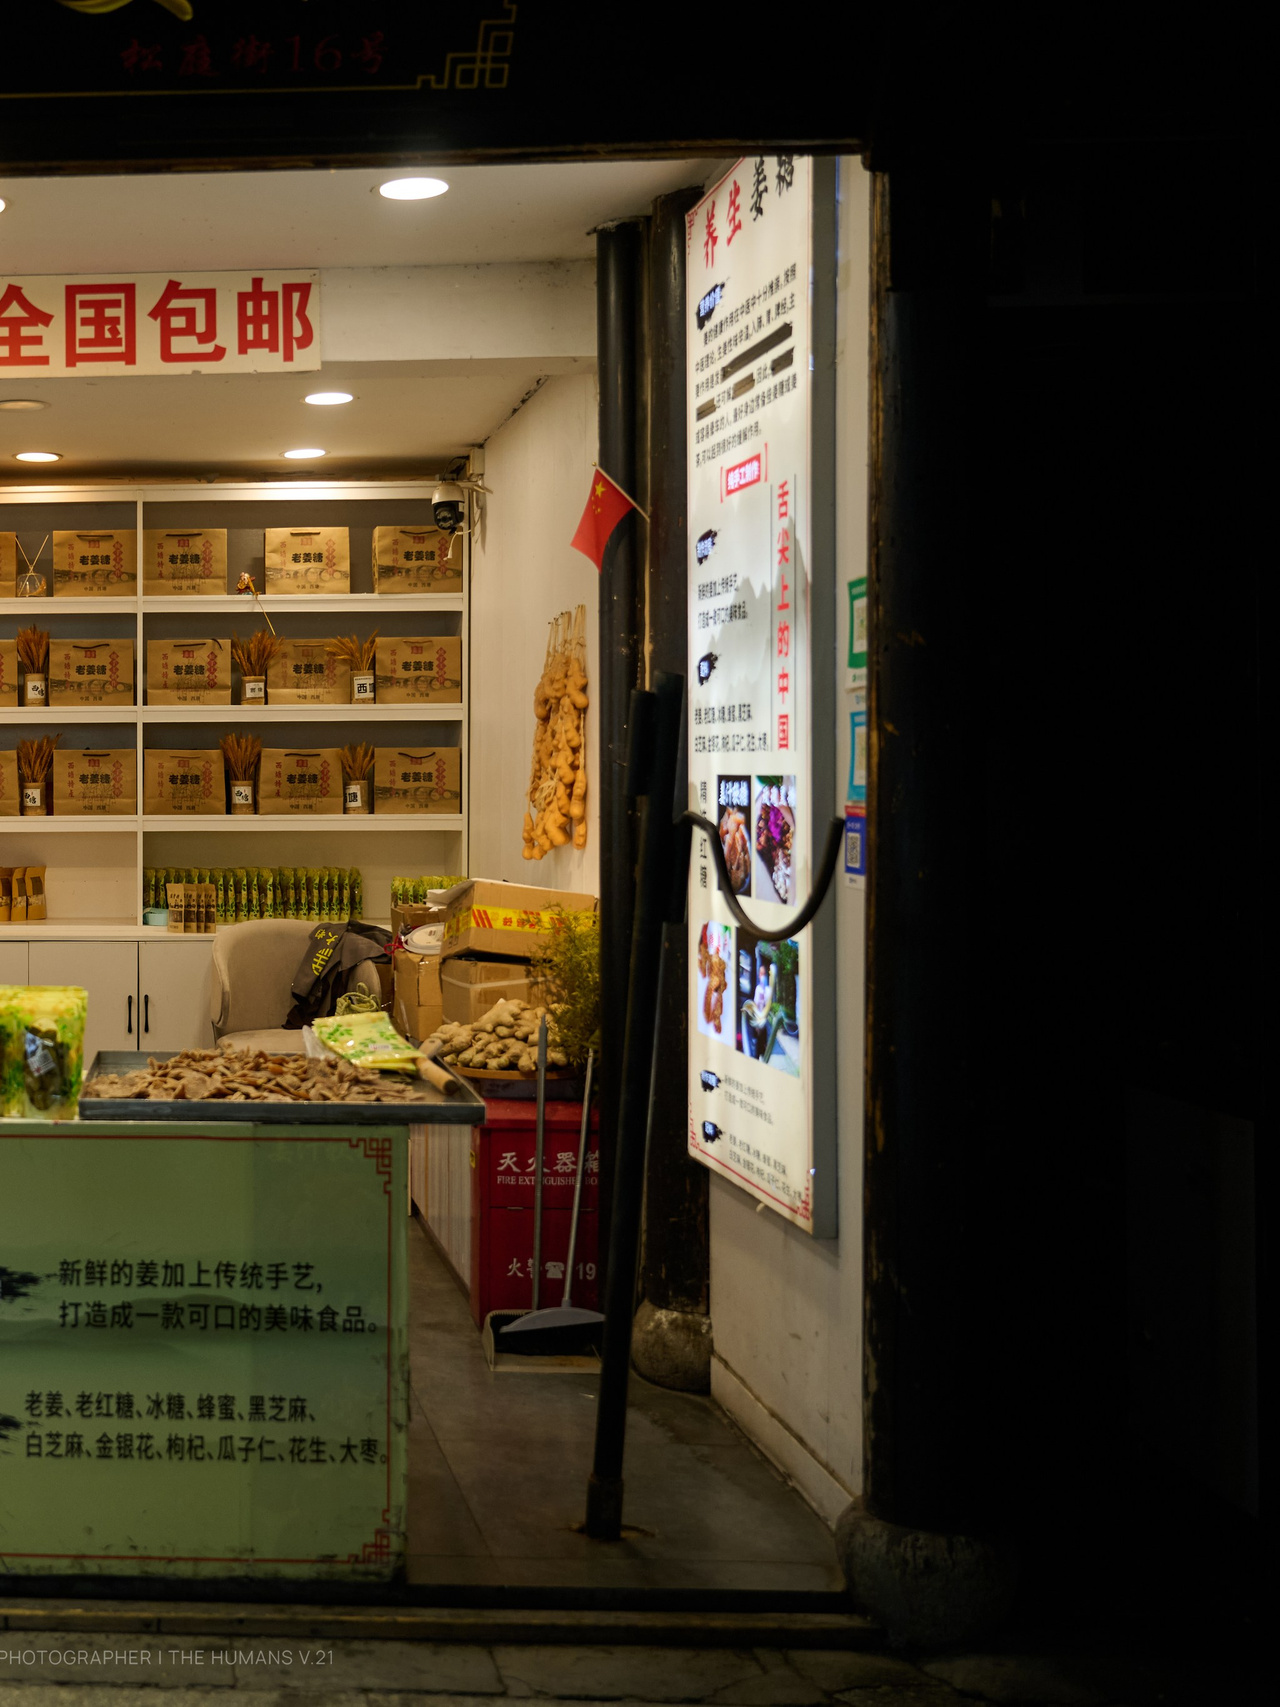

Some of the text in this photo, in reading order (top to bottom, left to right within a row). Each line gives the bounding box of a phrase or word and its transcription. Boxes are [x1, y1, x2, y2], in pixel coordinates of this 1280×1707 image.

[80, 555, 111, 565] 老姜糖
[168, 554, 200, 564] 老姜糖
[292, 552, 323, 563] 老姜糖
[404, 550, 436, 561] 老姜糖
[776, 480, 790, 750] 舌尖上的中国
[76, 664, 106, 675] 老姜糖
[174, 664, 205, 676] 老姜糖
[292, 664, 324, 674] 老姜糖
[402, 660, 434, 672] 老姜糖
[79, 774, 110, 784] 老姜糖
[169, 774, 200, 785] 老姜糖
[286, 774, 318, 784] 老姜糖
[401, 772, 434, 782] 老姜糖
[496, 1175, 517, 1185] FIRE
[518, 1176, 577, 1186] EXTGUISHE
[58, 1259, 324, 1294] 新鲜的姜加上传统手艺，
[58, 1301, 378, 1335] 打造成一款可口的美味食品。
[25, 1390, 317, 1424] 老姜、老红糖、冰糖、蜂蜜、黑芝麻、
[25, 1433, 390, 1466] 白芝麻、金银花、枸杞、瓜子仁、花生、大枣。
